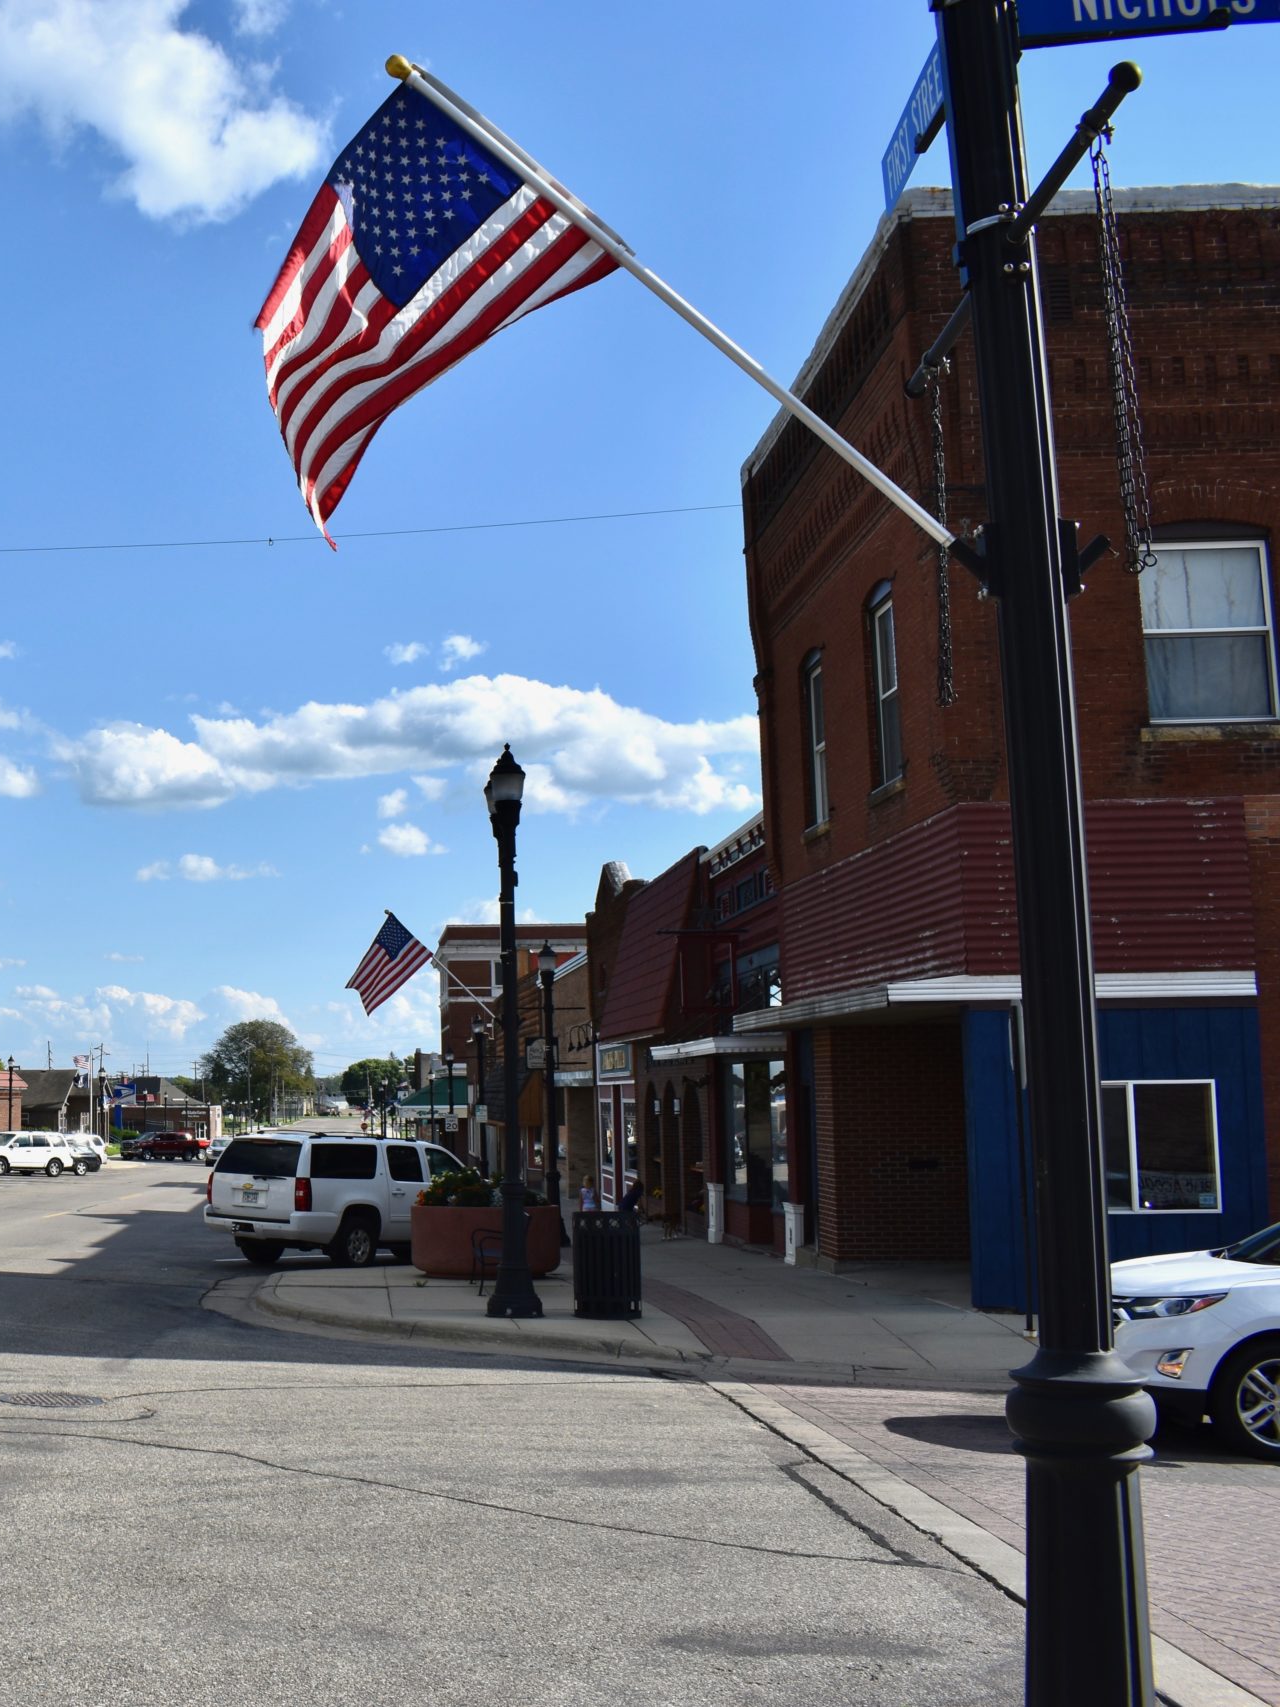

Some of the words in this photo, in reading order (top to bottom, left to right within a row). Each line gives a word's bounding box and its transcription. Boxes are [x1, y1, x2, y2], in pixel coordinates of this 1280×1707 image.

[886, 117, 911, 199] FIRST
[911, 52, 943, 135] STREE
[446, 1122, 457, 1130] 20
